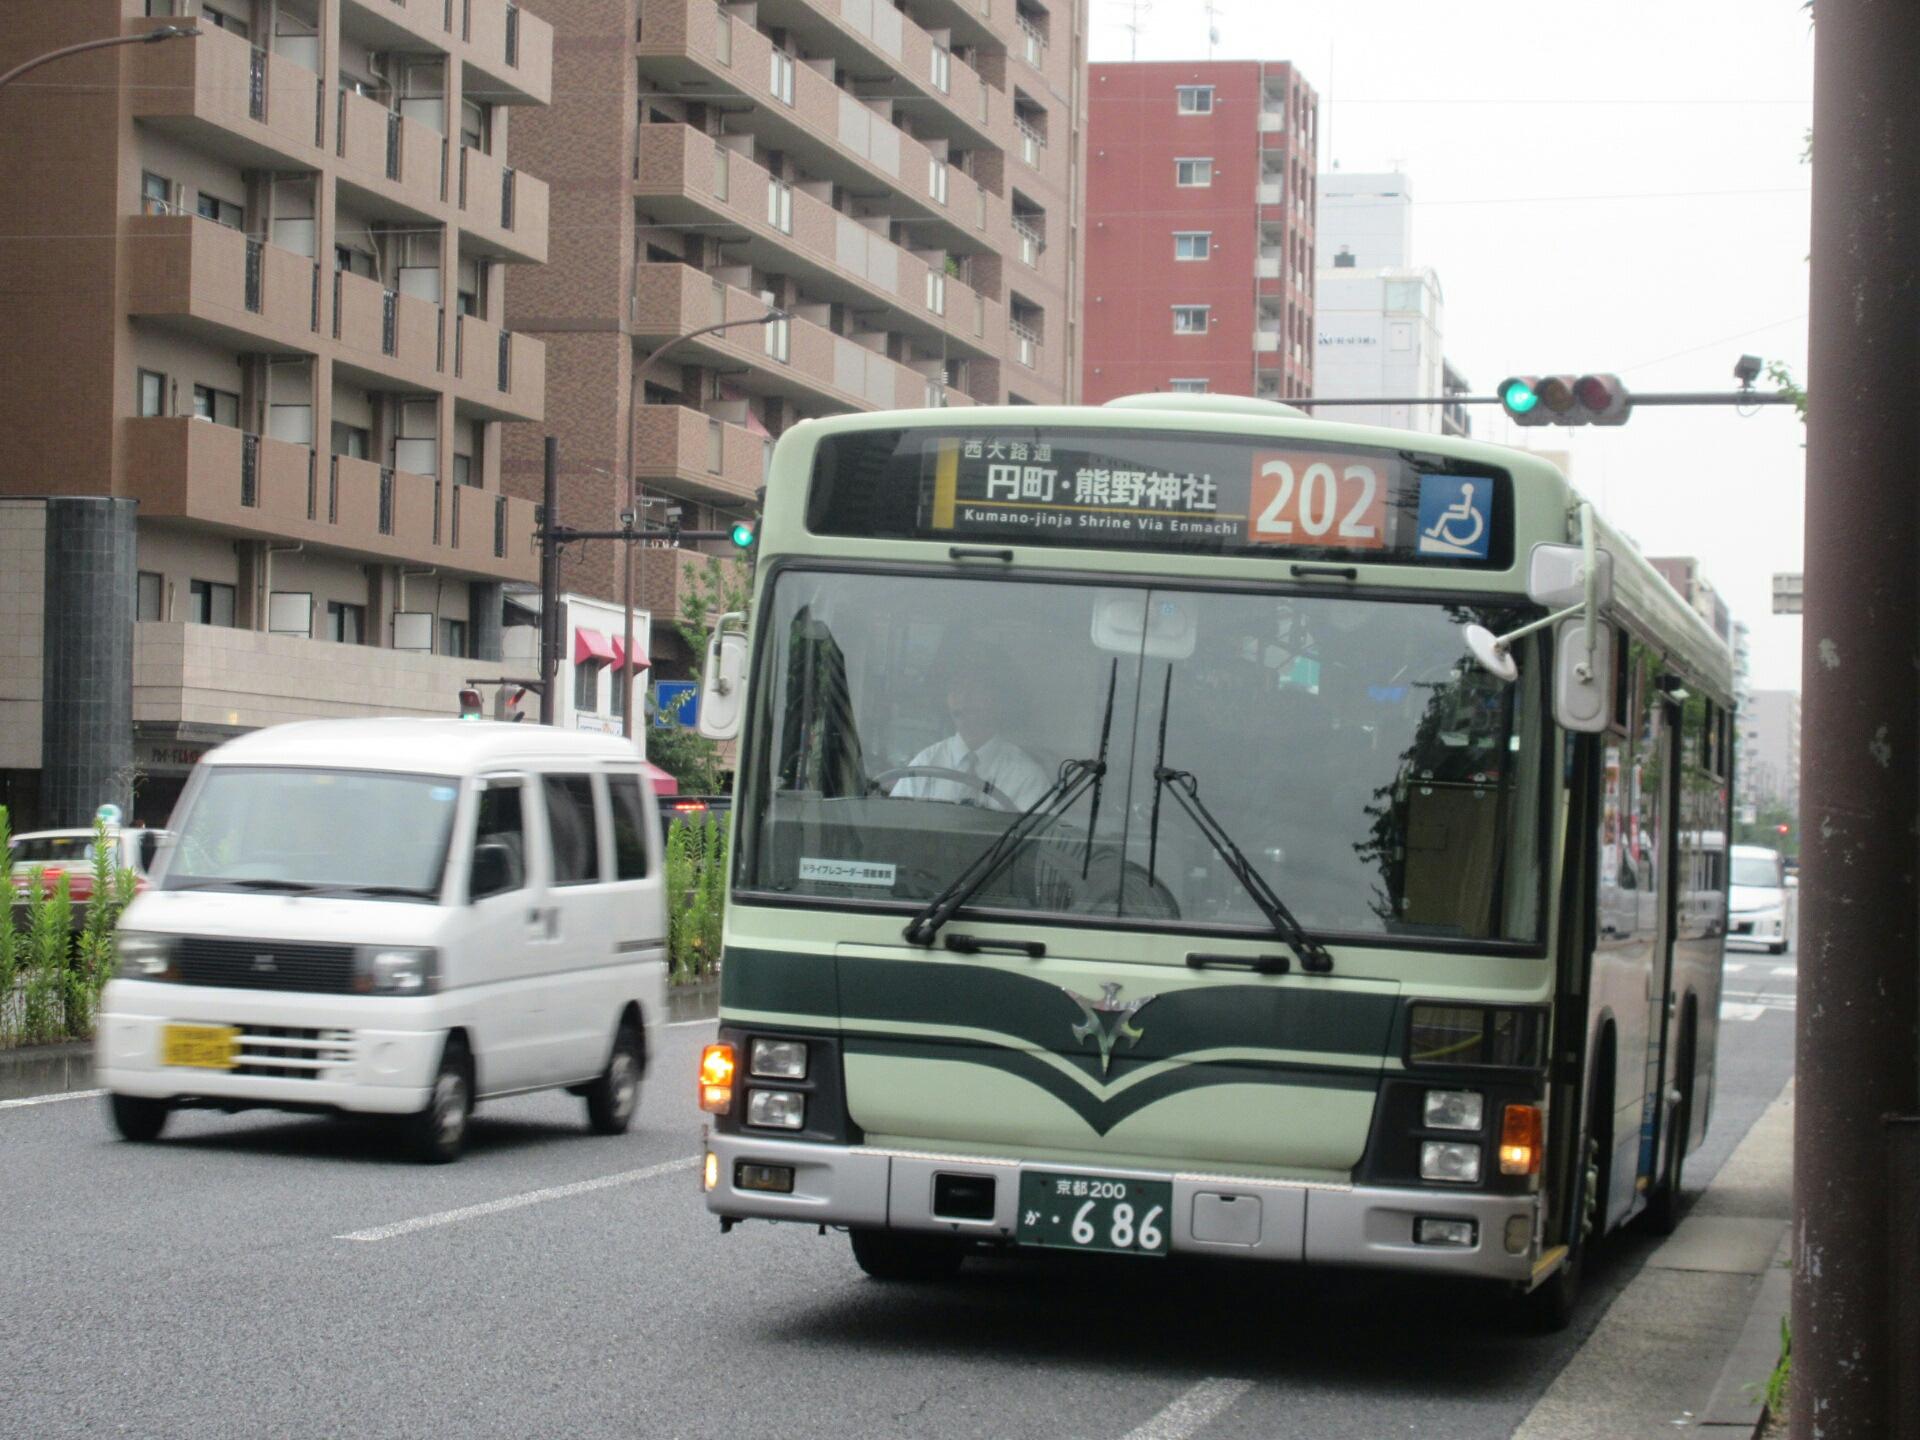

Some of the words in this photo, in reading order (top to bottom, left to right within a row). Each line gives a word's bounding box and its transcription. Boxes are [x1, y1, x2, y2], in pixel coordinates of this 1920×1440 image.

[964, 440, 1051, 462] 西大路通
[986, 464, 1217, 509] 円町・熊野神社
[1256, 460, 1376, 538] 202
[964, 508, 1073, 529] Kumano-jinja
[1079, 515, 1131, 529] Shrine
[1138, 518, 1164, 531] Via
[1170, 520, 1238, 535] Enmachi
[1056, 1180, 1126, 1199] 京都200
